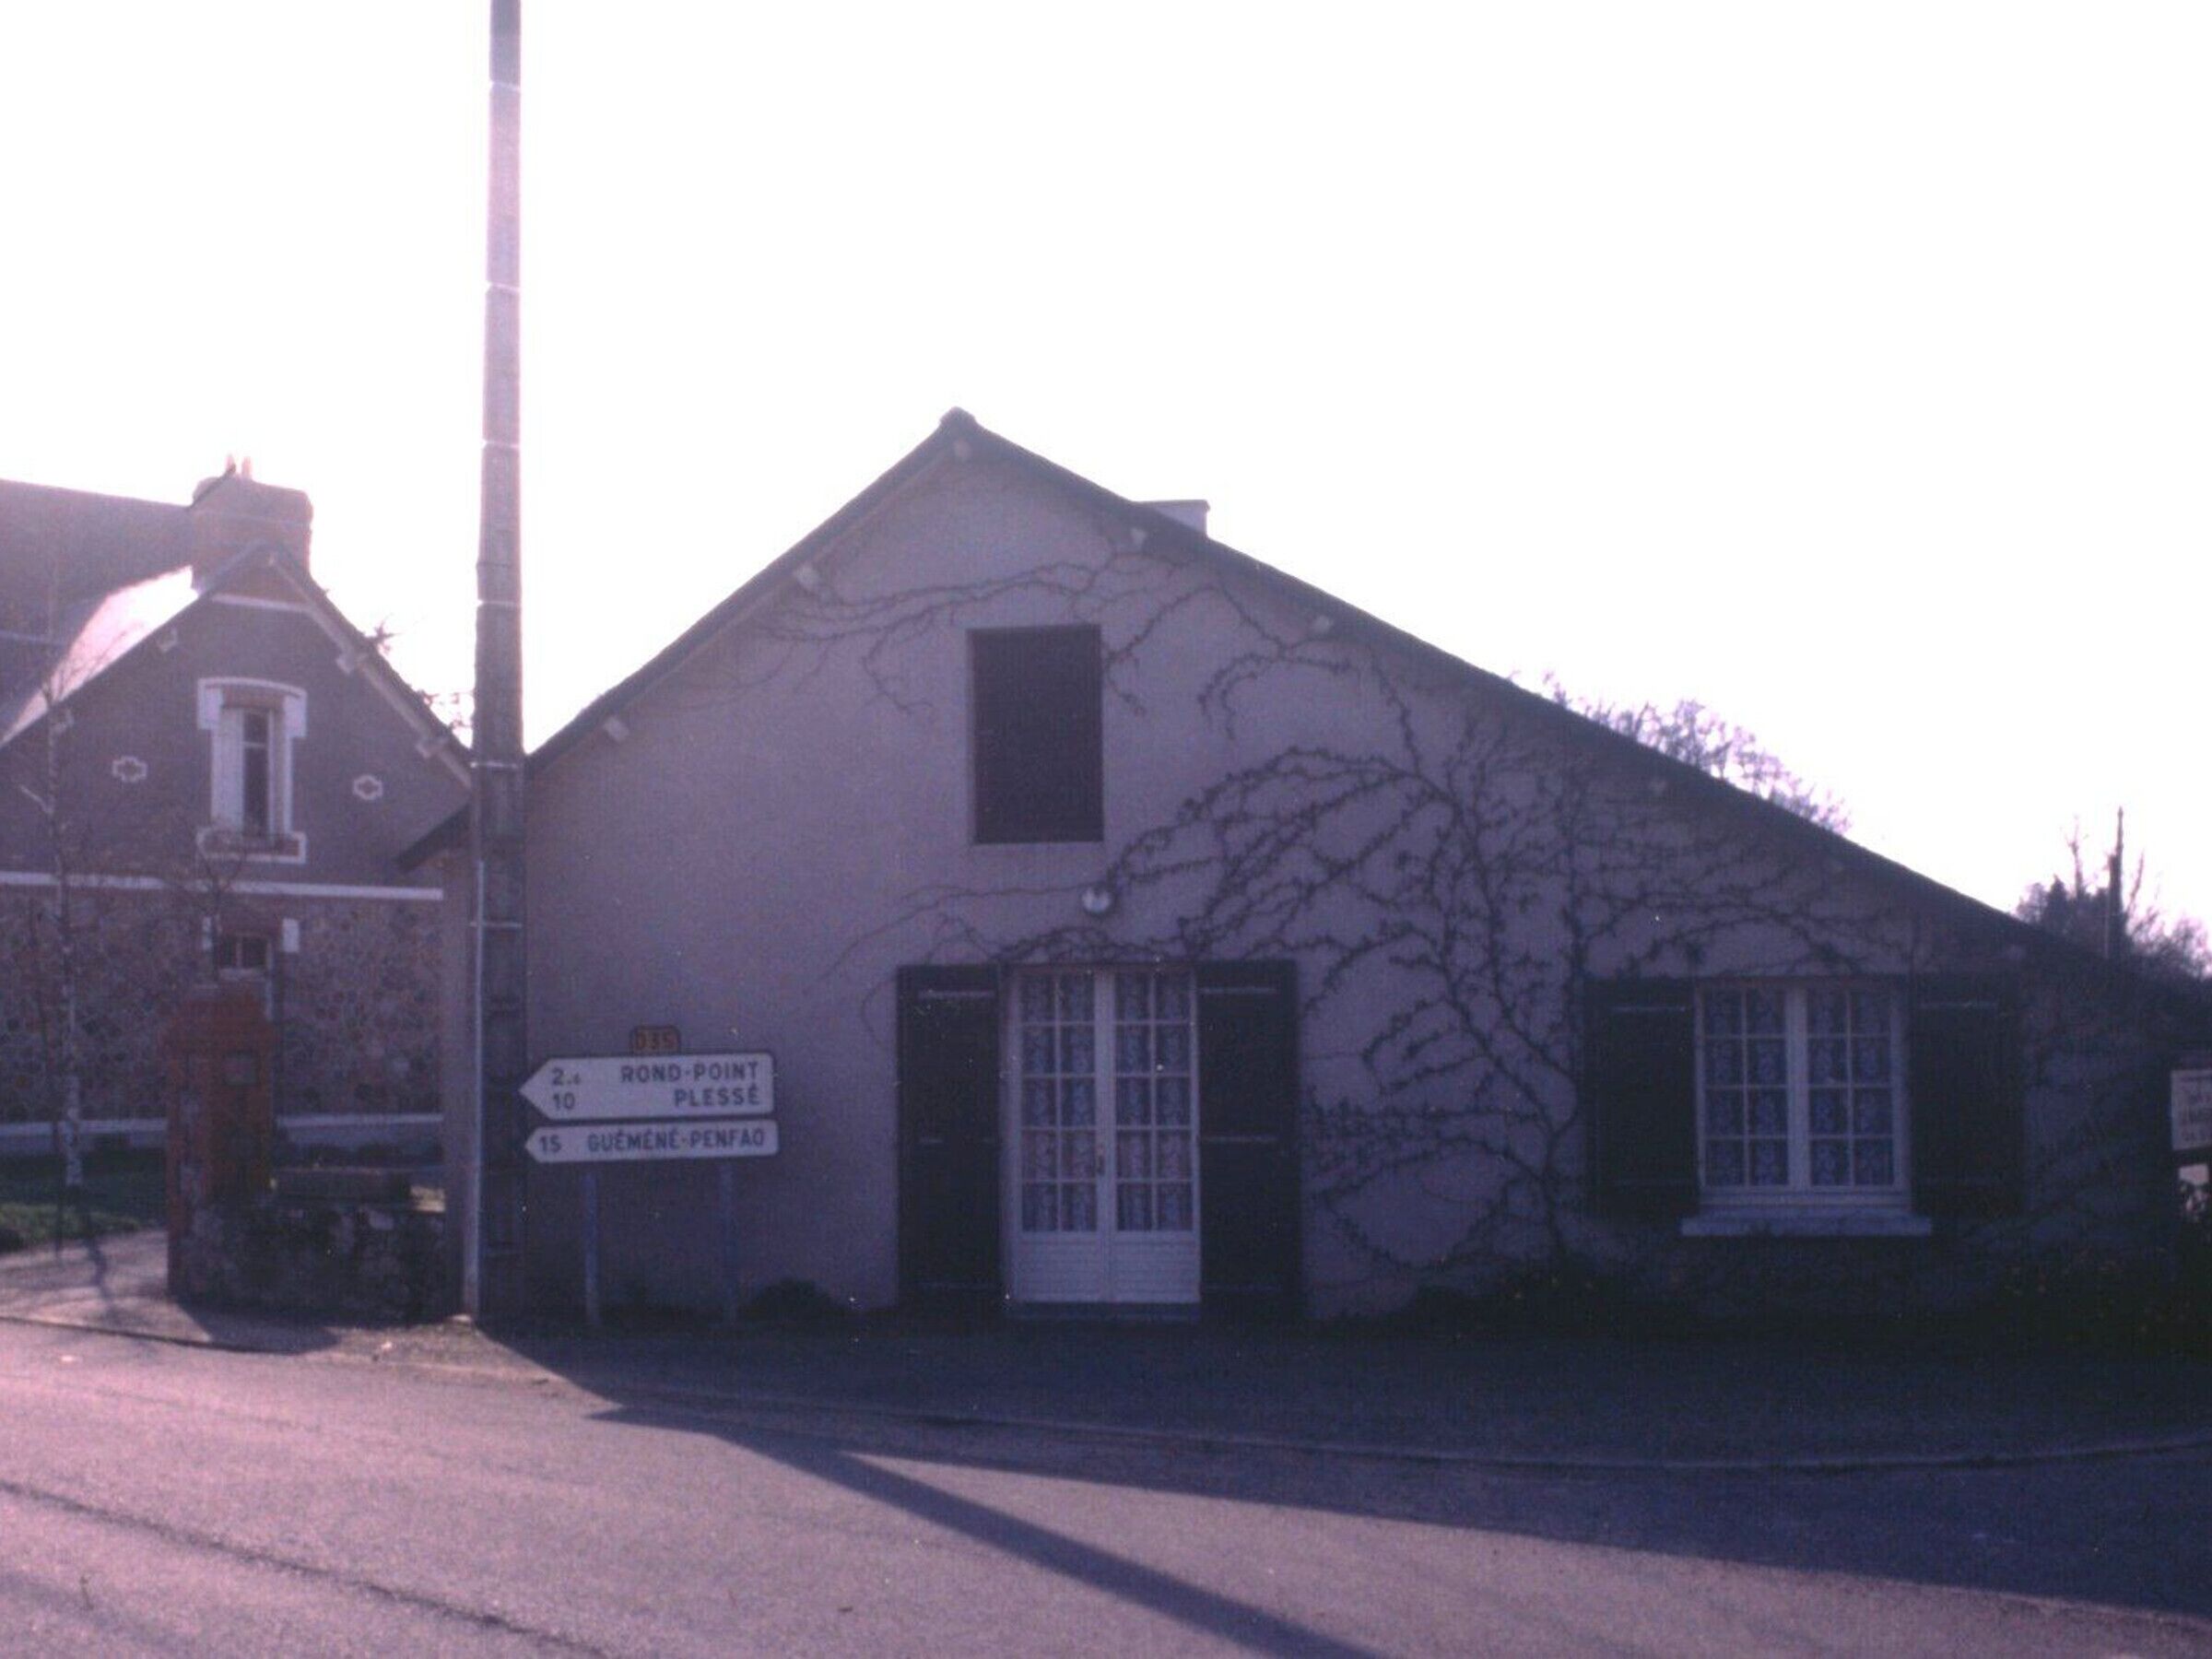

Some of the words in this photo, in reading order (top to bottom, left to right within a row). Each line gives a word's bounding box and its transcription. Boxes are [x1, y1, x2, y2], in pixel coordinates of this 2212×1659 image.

[621, 1062, 759, 1083] ROND-POINT
[553, 1092, 575, 1110] 10
[675, 1084, 760, 1107] PLESSÉ
[540, 1135, 561, 1153] 15
[587, 1127, 764, 1152] GUÉMÉNÉ-PENFAO
